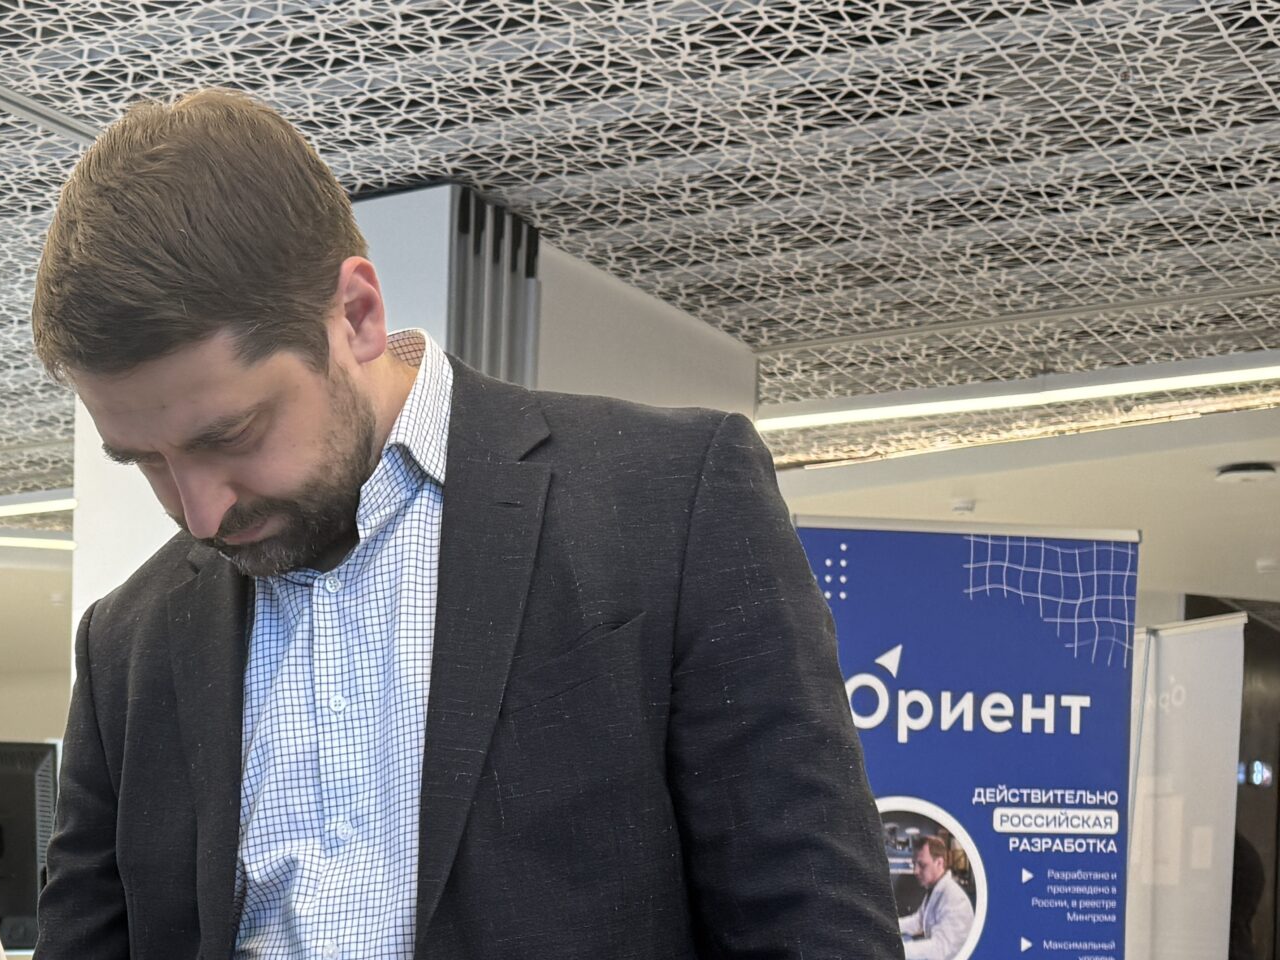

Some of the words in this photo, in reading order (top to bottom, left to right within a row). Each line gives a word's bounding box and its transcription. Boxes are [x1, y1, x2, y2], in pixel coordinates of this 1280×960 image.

[845, 674, 1090, 743] Ориент
[972, 785, 1118, 805] ДЕЙСТВИТЕЛЬНО
[999, 811, 1113, 829] РОССИЙСКАЯ
[1009, 837, 1117, 853] РАЗРАБОТКА
[1047, 869, 1110, 881] Разработано
[1047, 884, 1110, 895] произведено
[1031, 899, 1069, 909] России,
[1079, 900, 1117, 910] реестре
[1067, 912, 1116, 924] Минпрома
[1043, 939, 1115, 951] Максимальный
